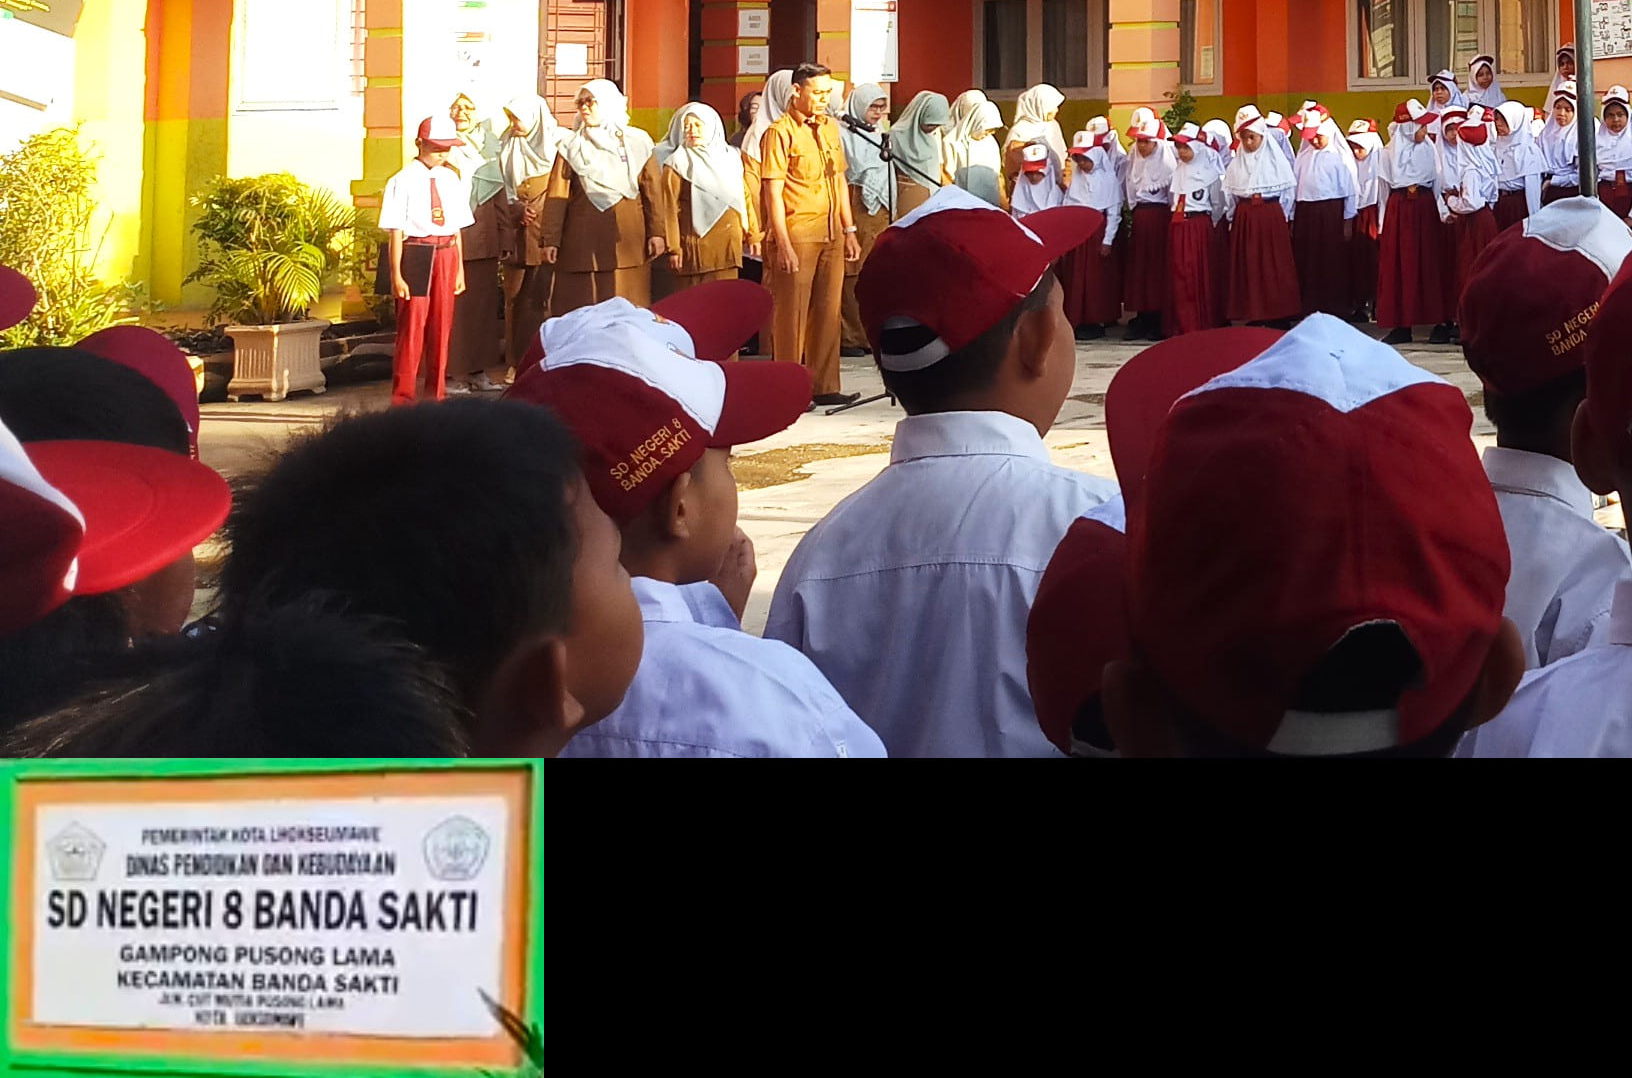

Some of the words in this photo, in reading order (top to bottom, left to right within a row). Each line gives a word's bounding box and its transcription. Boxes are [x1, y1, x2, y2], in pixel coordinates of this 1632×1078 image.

[1545, 329, 1562, 344] SD
[1551, 329, 1588, 356] BANDA
[609, 462, 629, 480] SD
[630, 425, 673, 465] NEGERI
[671, 417, 682, 429] 8
[620, 456, 662, 491] BANDA
[660, 428, 692, 459] SAKTI
[231, 826, 266, 843] KOTA
[126, 853, 169, 878] DINAS
[262, 853, 293, 876] DAN
[298, 852, 396, 876] KEBUDAYAAN
[48, 889, 88, 928] SD
[96, 889, 213, 930] NEGERI
[222, 889, 243, 930] 8
[253, 889, 368, 931] BANDA
[377, 890, 478, 932] SAKTI
[119, 944, 228, 964] GAMPONG
[234, 945, 326, 966] PUSONG
[332, 947, 396, 967] LAMA
[117, 970, 245, 991] KECAMATAN
[252, 972, 327, 993] BANDA
[333, 973, 399, 995] SAKTI
